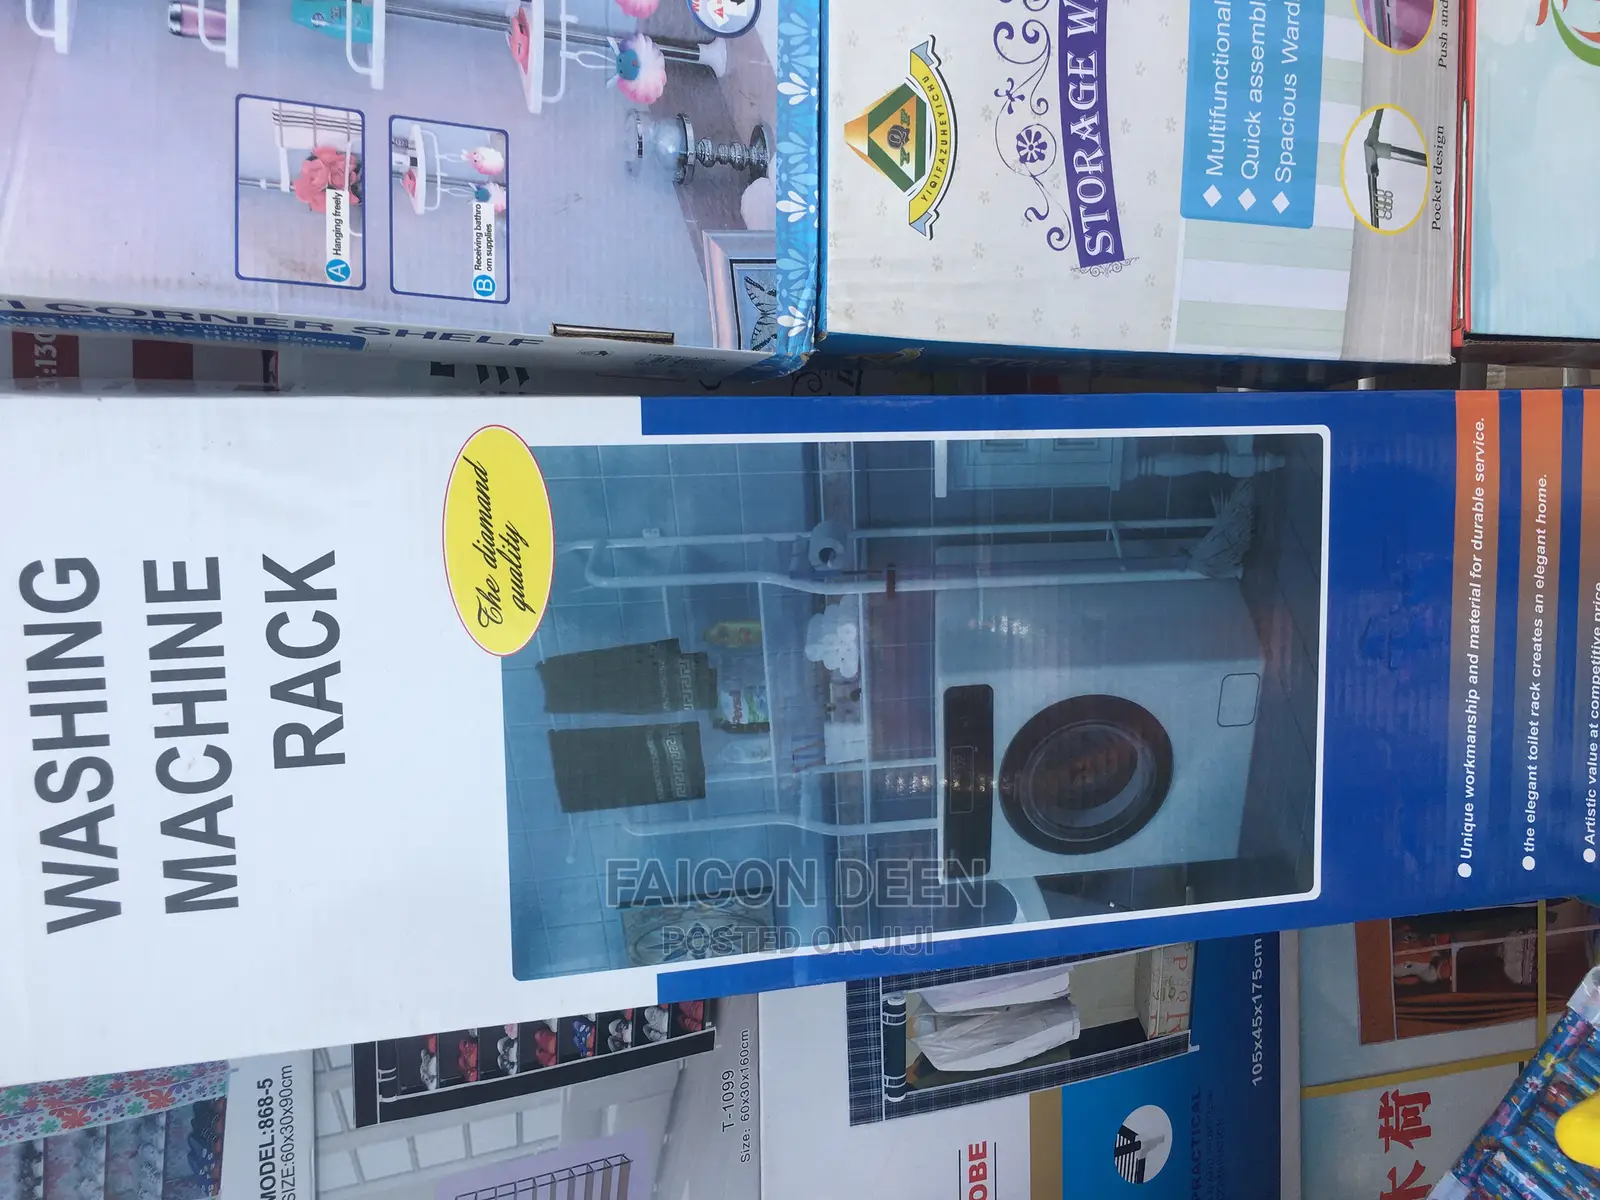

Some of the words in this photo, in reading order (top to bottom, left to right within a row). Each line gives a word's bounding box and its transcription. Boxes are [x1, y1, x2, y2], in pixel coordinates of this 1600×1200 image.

[1249, 0, 1270, 103] assembl
[1281, 0, 1300, 64] Ward
[1438, 32, 1448, 69] Push
[1205, 0, 1231, 176] Multifunctional
[1066, 50, 1115, 257] STORAGE
[1241, 111, 1262, 180] Quick
[1274, 73, 1297, 184] Spacious
[1433, 125, 1445, 175] design
[331, 192, 343, 217] freely
[474, 204, 482, 231] bathro
[1432, 180, 1443, 231] Pocket
[332, 218, 344, 256] Hanging
[474, 232, 483, 271] Receiving
[484, 223, 493, 257] supplies
[329, 263, 346, 277] A
[476, 278, 493, 292] B
[44, 303, 333, 331] CORNER
[351, 325, 544, 347] SHELF
[1472, 417, 1485, 483] service.
[463, 455, 498, 569] diamand
[1471, 487, 1484, 550] durable
[1535, 474, 1548, 524] home.
[496, 520, 536, 614] quality
[1469, 554, 1482, 578] for
[1534, 528, 1548, 589] elegant
[474, 574, 503, 628] The
[1468, 583, 1482, 650] material
[1534, 594, 1544, 614] an
[262, 550, 346, 769] RACK
[1466, 653, 1479, 684] and
[1531, 619, 1543, 677] creates
[1588, 626, 1600, 719] competitive
[1528, 682, 1541, 716] rack
[18, 557, 122, 934] WASHING
[143, 557, 239, 914] MACHINE
[1463, 689, 1480, 798] workmanship
[1527, 721, 1539, 761] toilet
[1588, 723, 1599, 738] at
[1586, 743, 1598, 785] value
[1525, 765, 1539, 823] elegant
[1584, 789, 1597, 845] Artistic
[1460, 803, 1476, 859] Unique
[1524, 828, 1535, 852] the
[1251, 938, 1263, 1087] 105x45x175cm
[721, 1069, 735, 1132] T-1099
[739, 1029, 750, 1122] 60x30x160cm
